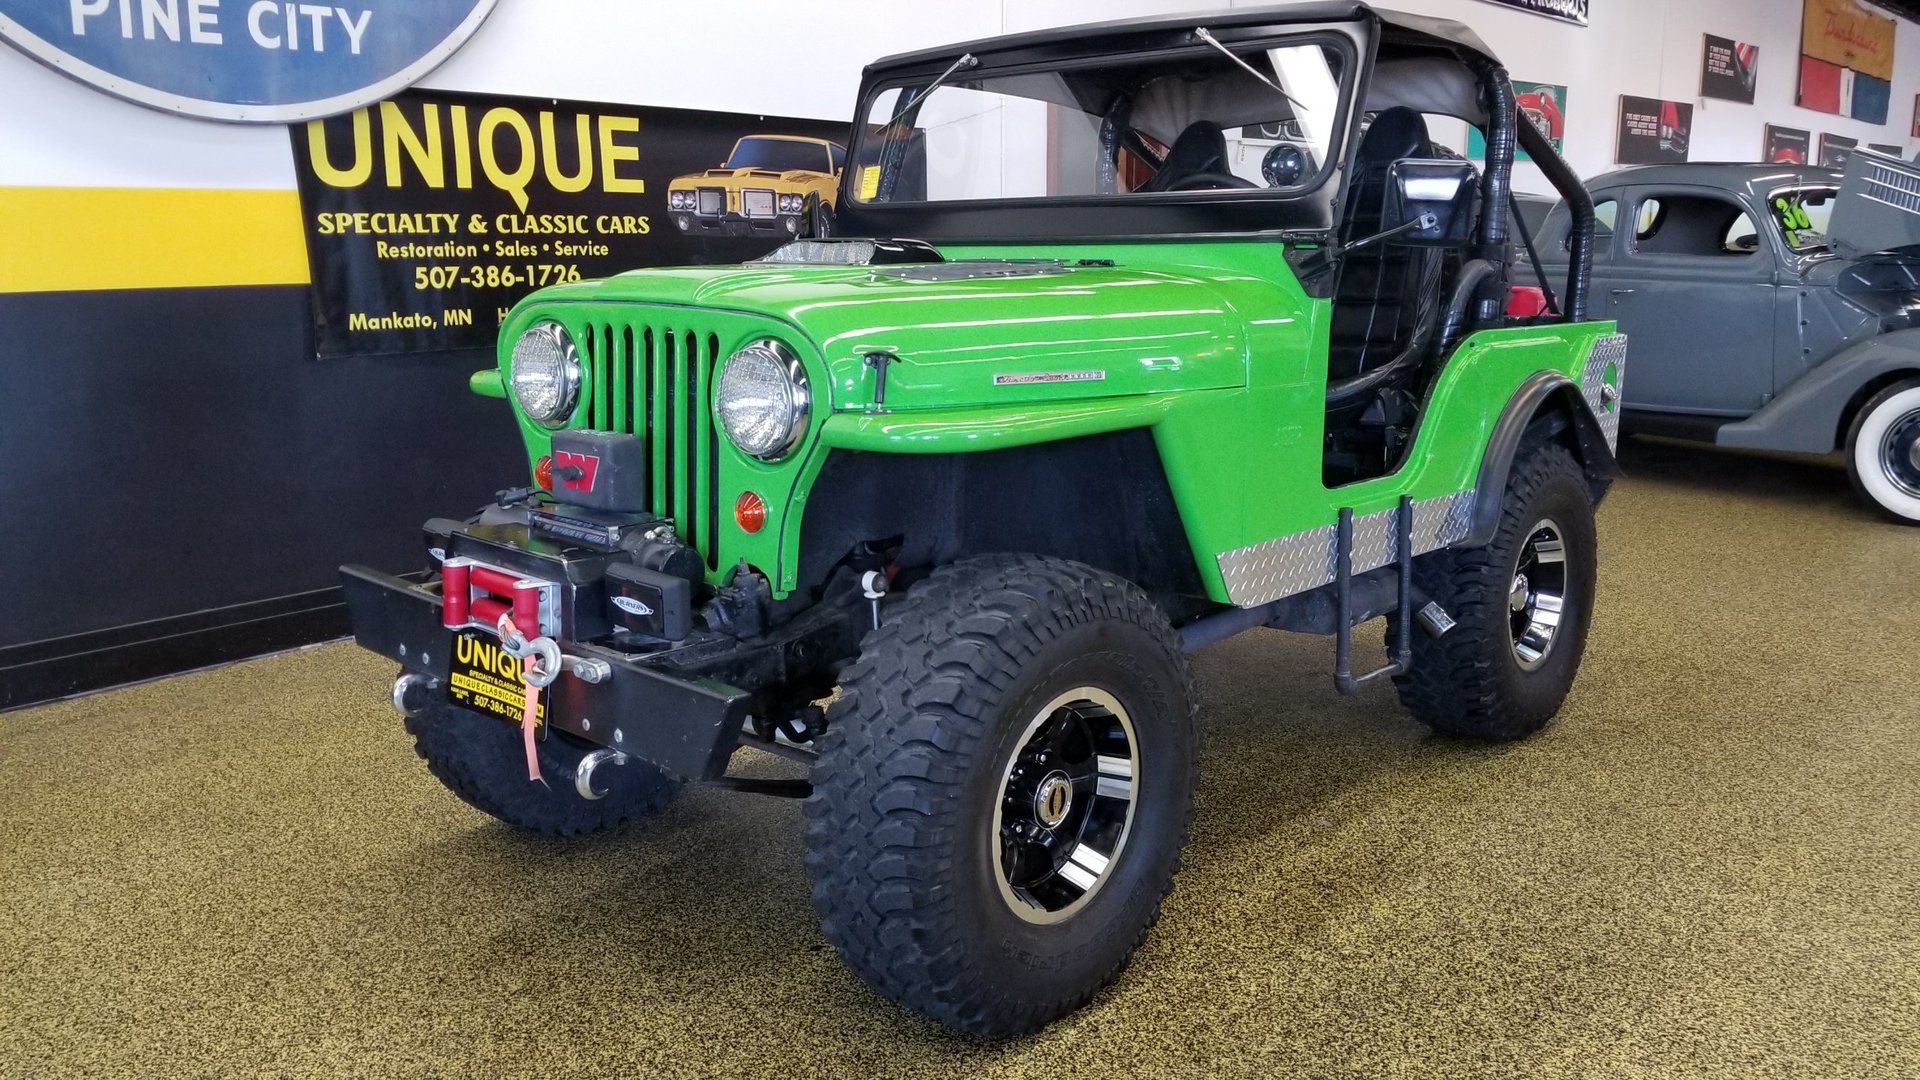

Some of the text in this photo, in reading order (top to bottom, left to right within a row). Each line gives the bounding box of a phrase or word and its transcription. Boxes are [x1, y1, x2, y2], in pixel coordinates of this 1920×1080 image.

[70, 0, 372, 55] PINE CITY
[307, 101, 645, 214] UNIQUE
[317, 212, 650, 235] SPECIALTY & CLASSIC CARS
[376, 239, 609, 259] Restoration Sales Service
[414, 264, 581, 290] 507-386-1726
[348, 308, 473, 331] Mankato, MN
[474, 694, 523, 722] 507-386-1726
